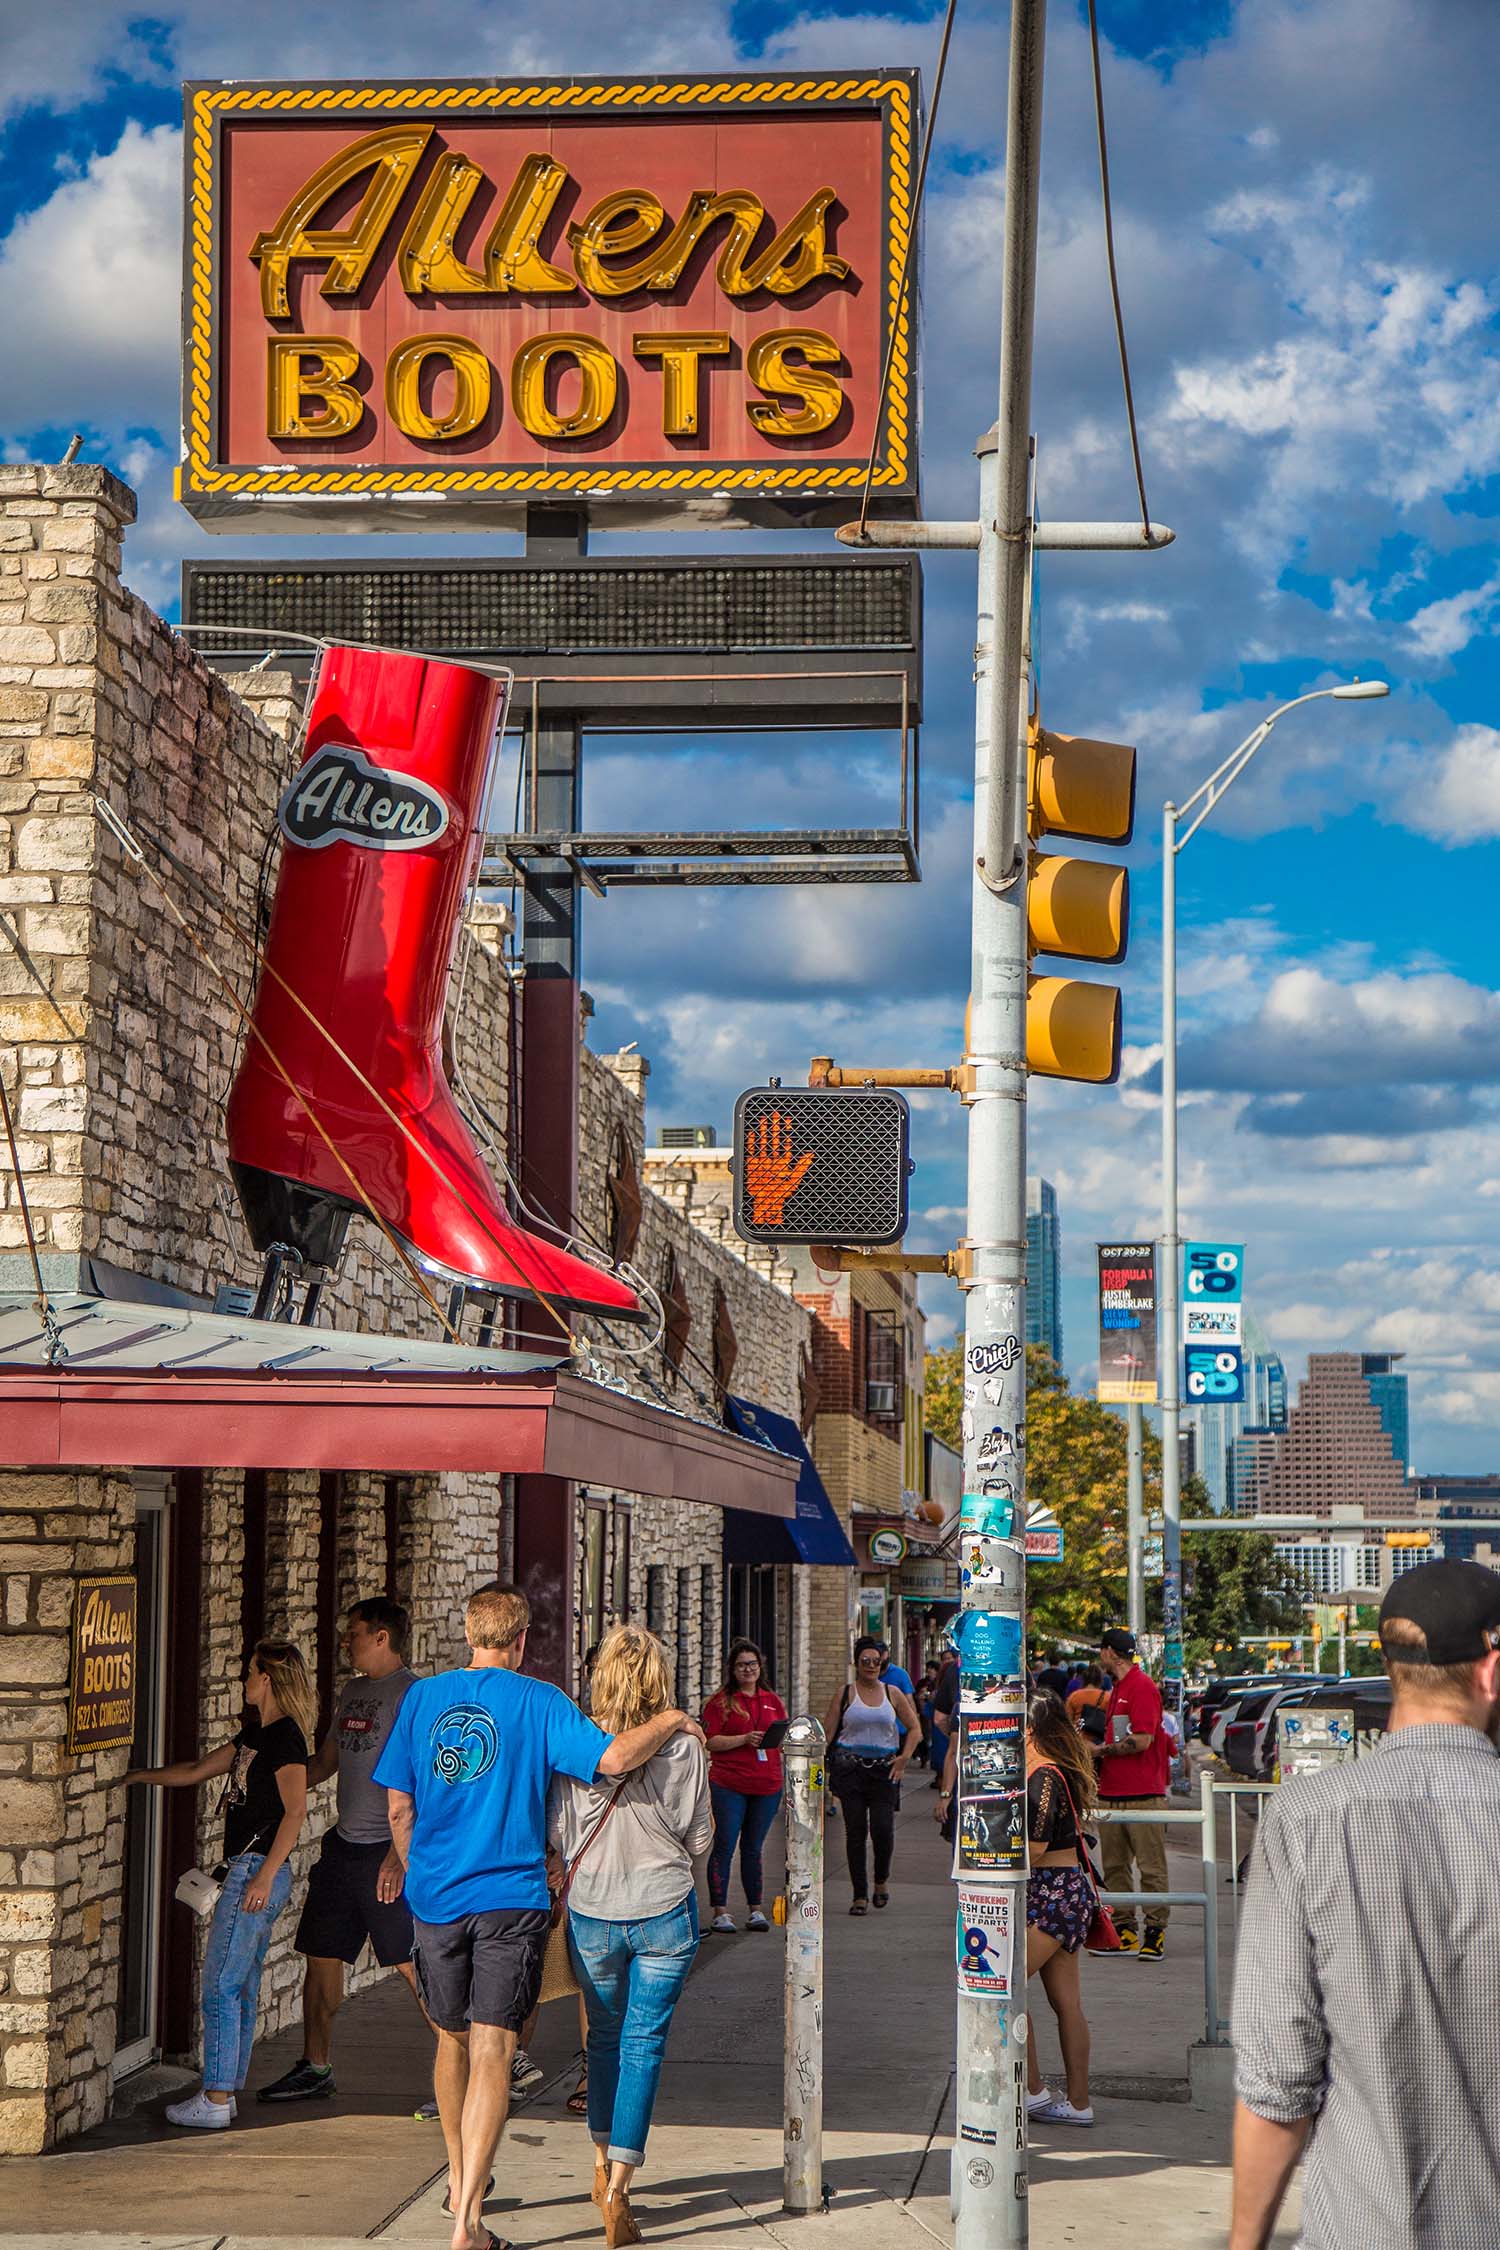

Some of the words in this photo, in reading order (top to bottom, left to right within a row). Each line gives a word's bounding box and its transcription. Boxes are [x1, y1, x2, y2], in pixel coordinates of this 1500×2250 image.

[249, 123, 850, 319] Allens
[266, 328, 843, 440] BOOTS
[296, 766, 431, 837] Allens
[1102, 1247, 1123, 1257] OCT
[1102, 1269, 1147, 1280] FORMULA
[1103, 1280, 1127, 1290] USGP
[1103, 1289, 1131, 1299] JUSTIN
[1103, 1298, 1153, 1309] TIMBERLAKE
[1103, 1309, 1130, 1319] STEVIE
[1189, 1312, 1236, 1321] SOUTH
[1103, 1318, 1141, 1328] WONDER
[1189, 1320, 1236, 1331] CONGRESS
[968, 1335, 1023, 1374] Chief
[81, 1589, 132, 1653] Allens
[83, 1652, 131, 1694] BOOTS
[77, 1704, 90, 1731] 1522
[99, 1699, 131, 1727] CONGRESS
[968, 1721, 983, 1731] 2017
[983, 1719, 1015, 1729] FORMULA
[969, 1894, 1008, 1905] WEEKEND
[981, 1905, 1008, 1916] CUTS
[1014, 2061, 1023, 2150] MIRA
